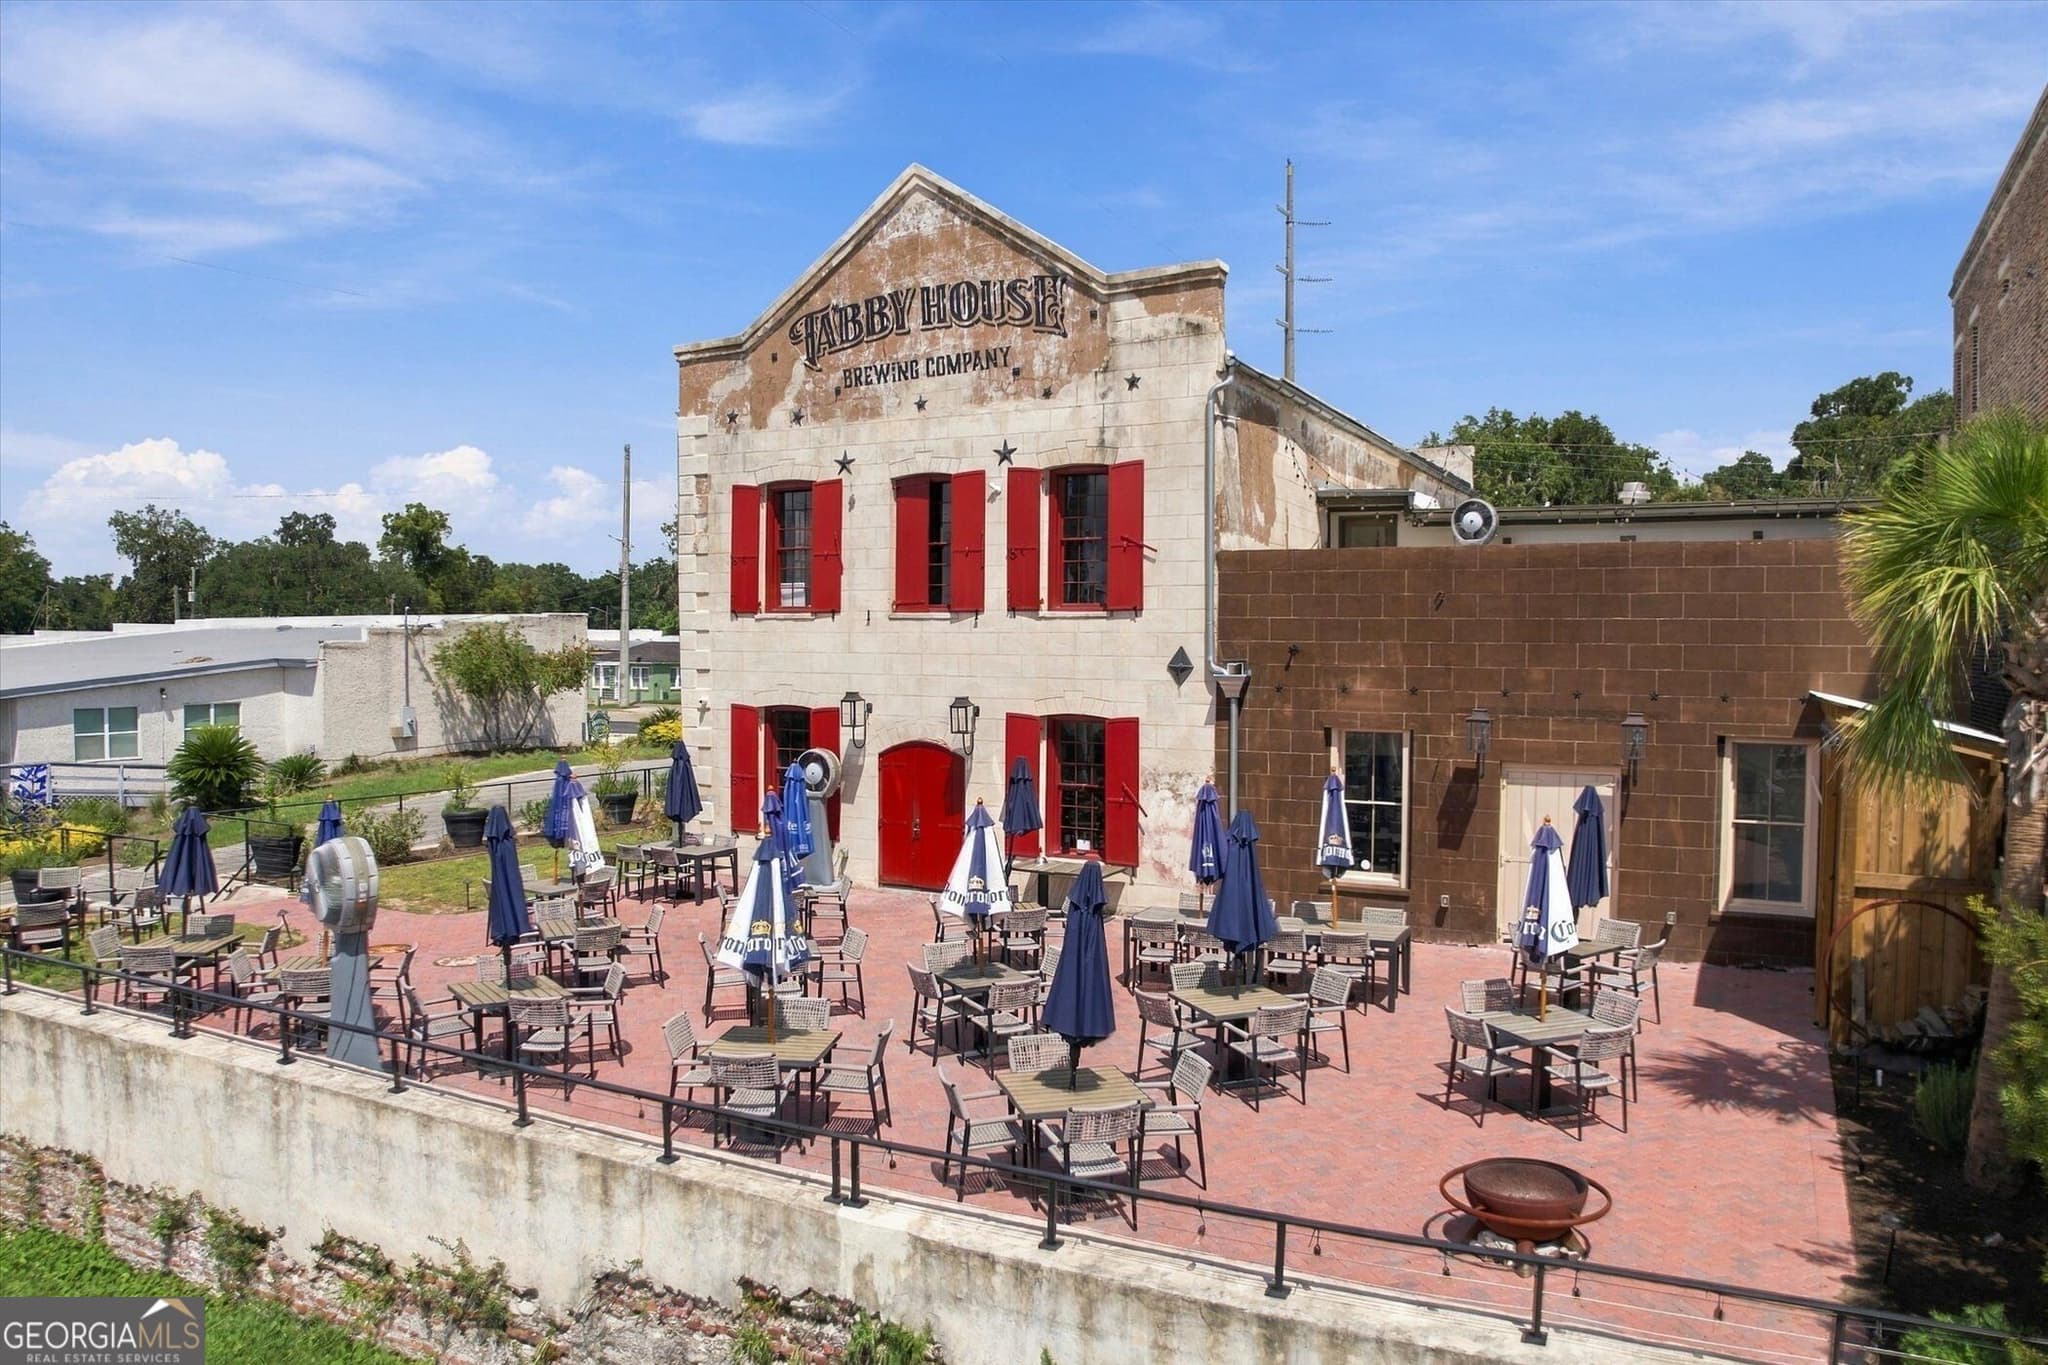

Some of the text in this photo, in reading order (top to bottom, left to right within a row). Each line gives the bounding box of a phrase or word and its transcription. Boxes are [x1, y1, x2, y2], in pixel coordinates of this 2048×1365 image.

[789, 275, 1068, 371] TABBY HOUSE
[926, 345, 1012, 377] COMPANY
